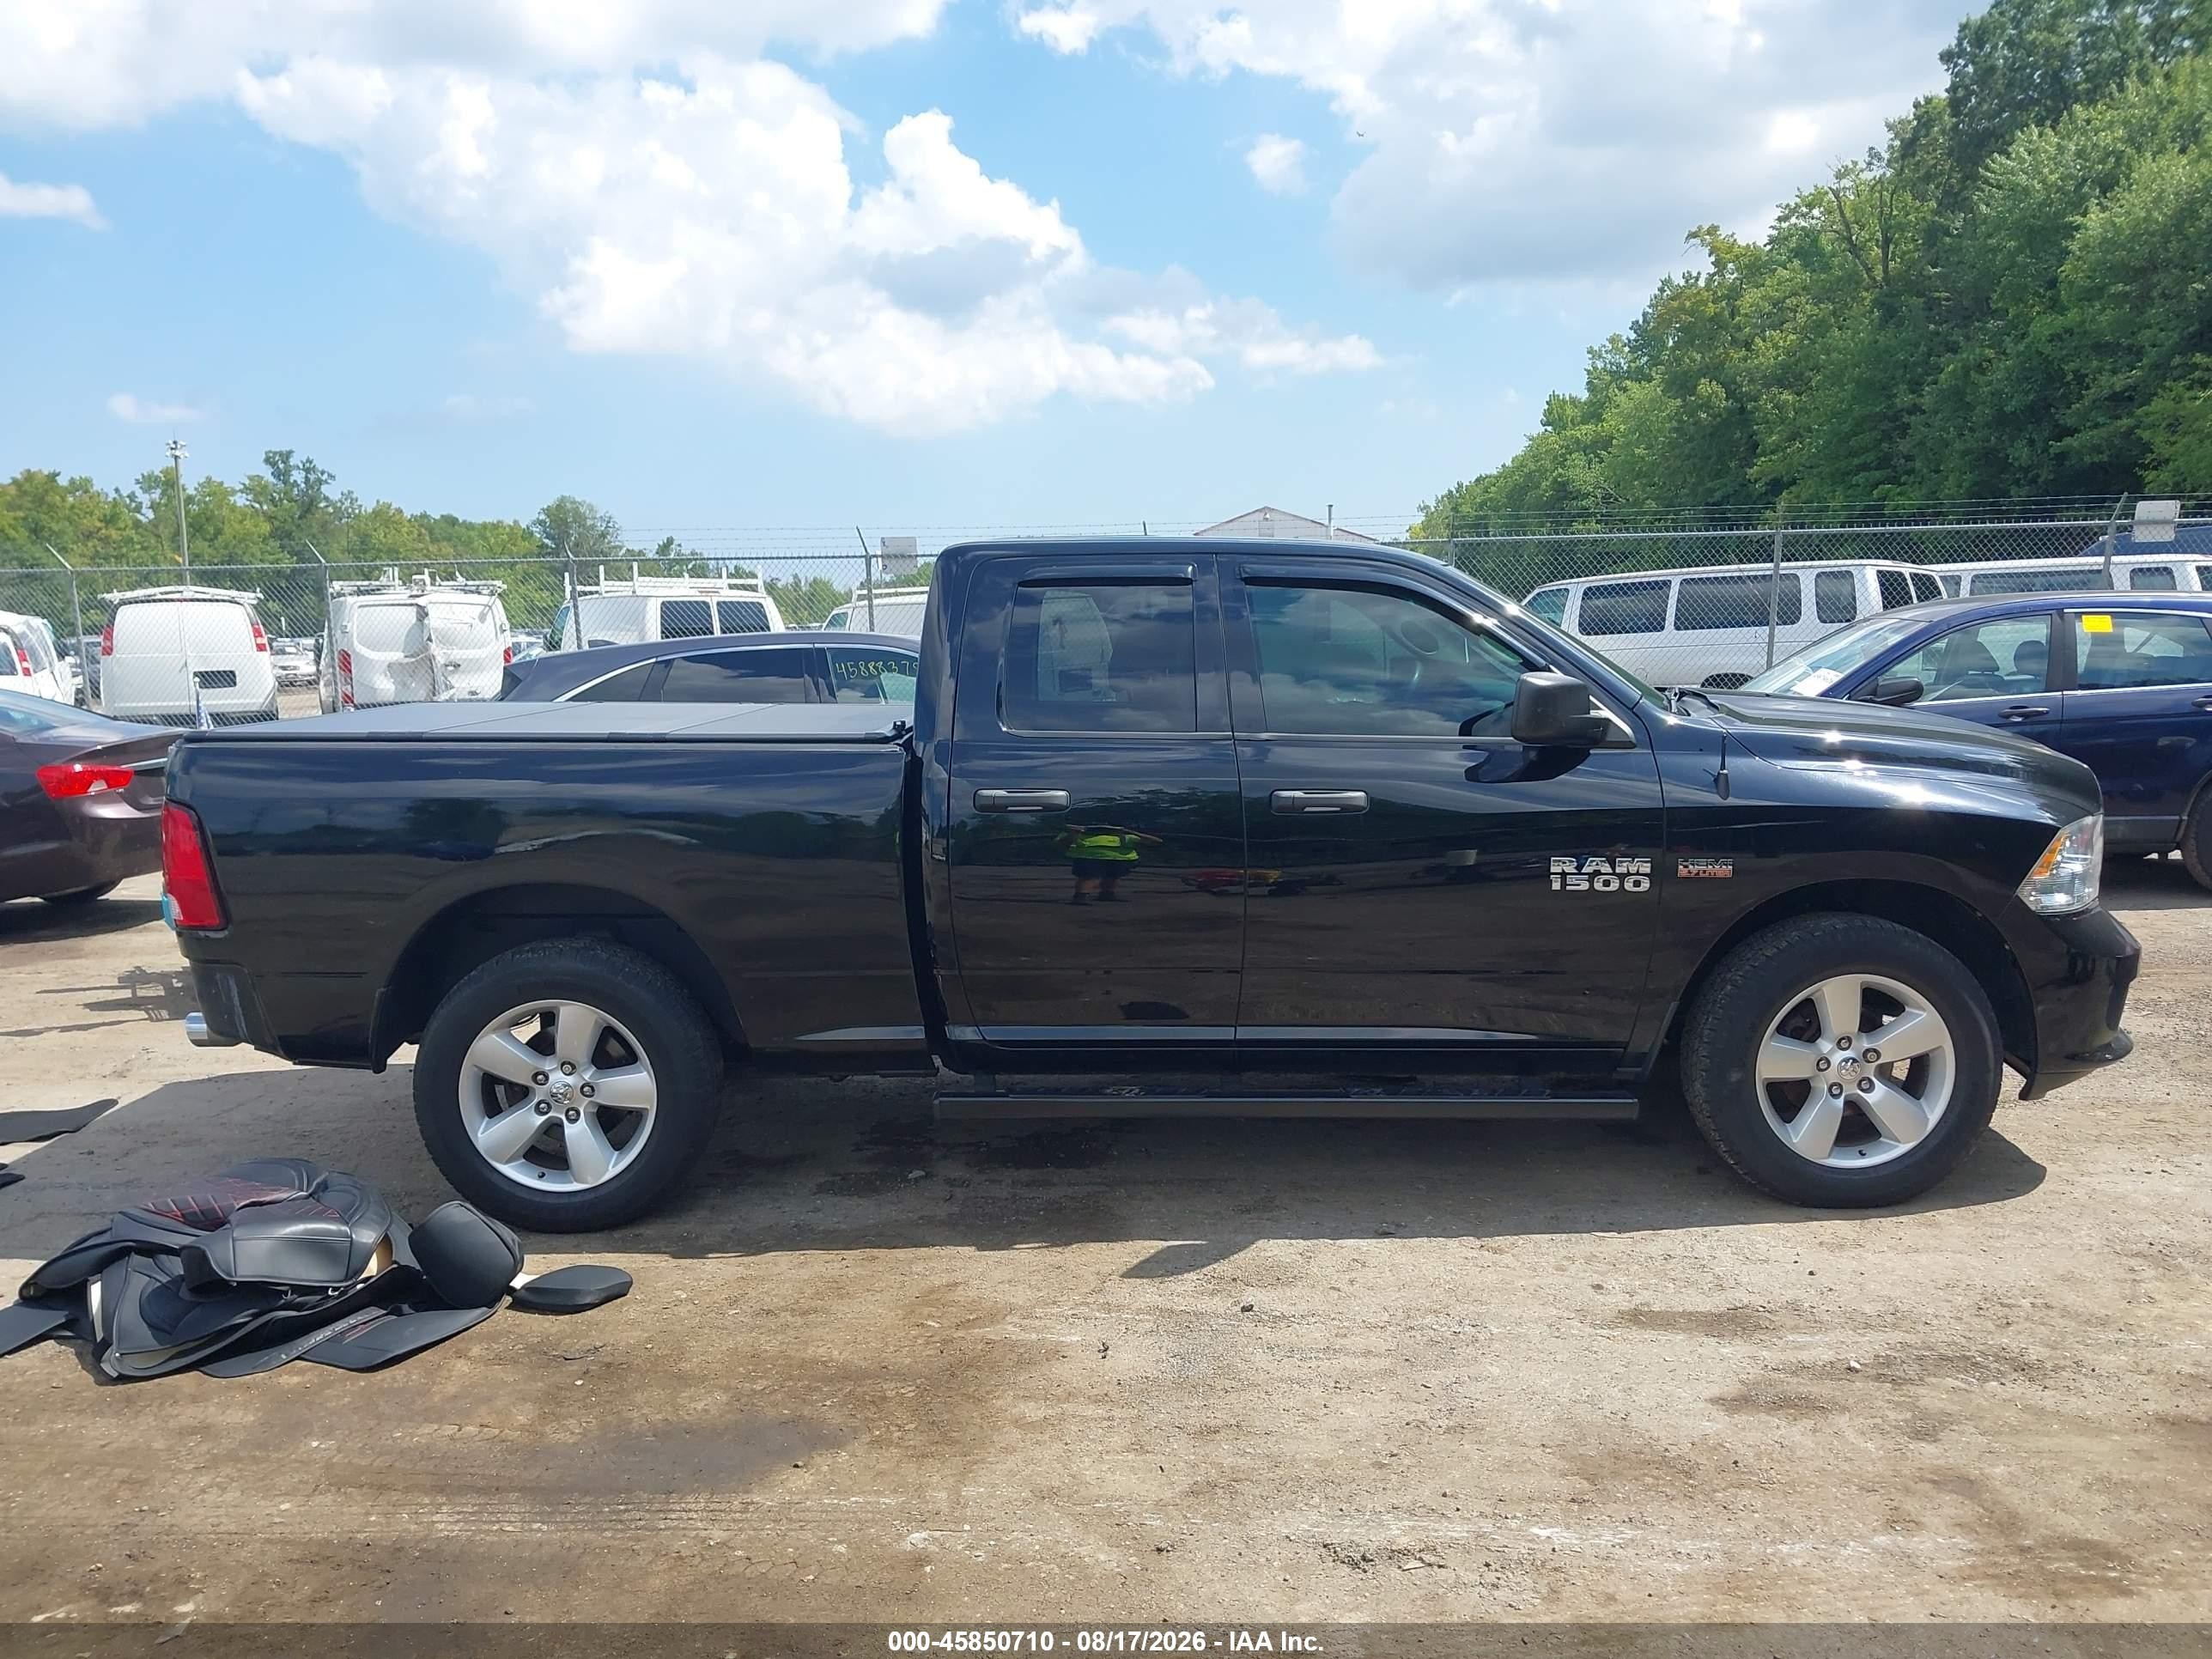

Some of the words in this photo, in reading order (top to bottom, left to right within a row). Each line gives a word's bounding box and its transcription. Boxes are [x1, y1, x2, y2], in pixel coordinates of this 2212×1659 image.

[1549, 856, 1652, 874] RAM
[1678, 858, 1733, 869] HEMI
[1549, 874, 1651, 892] 1500
